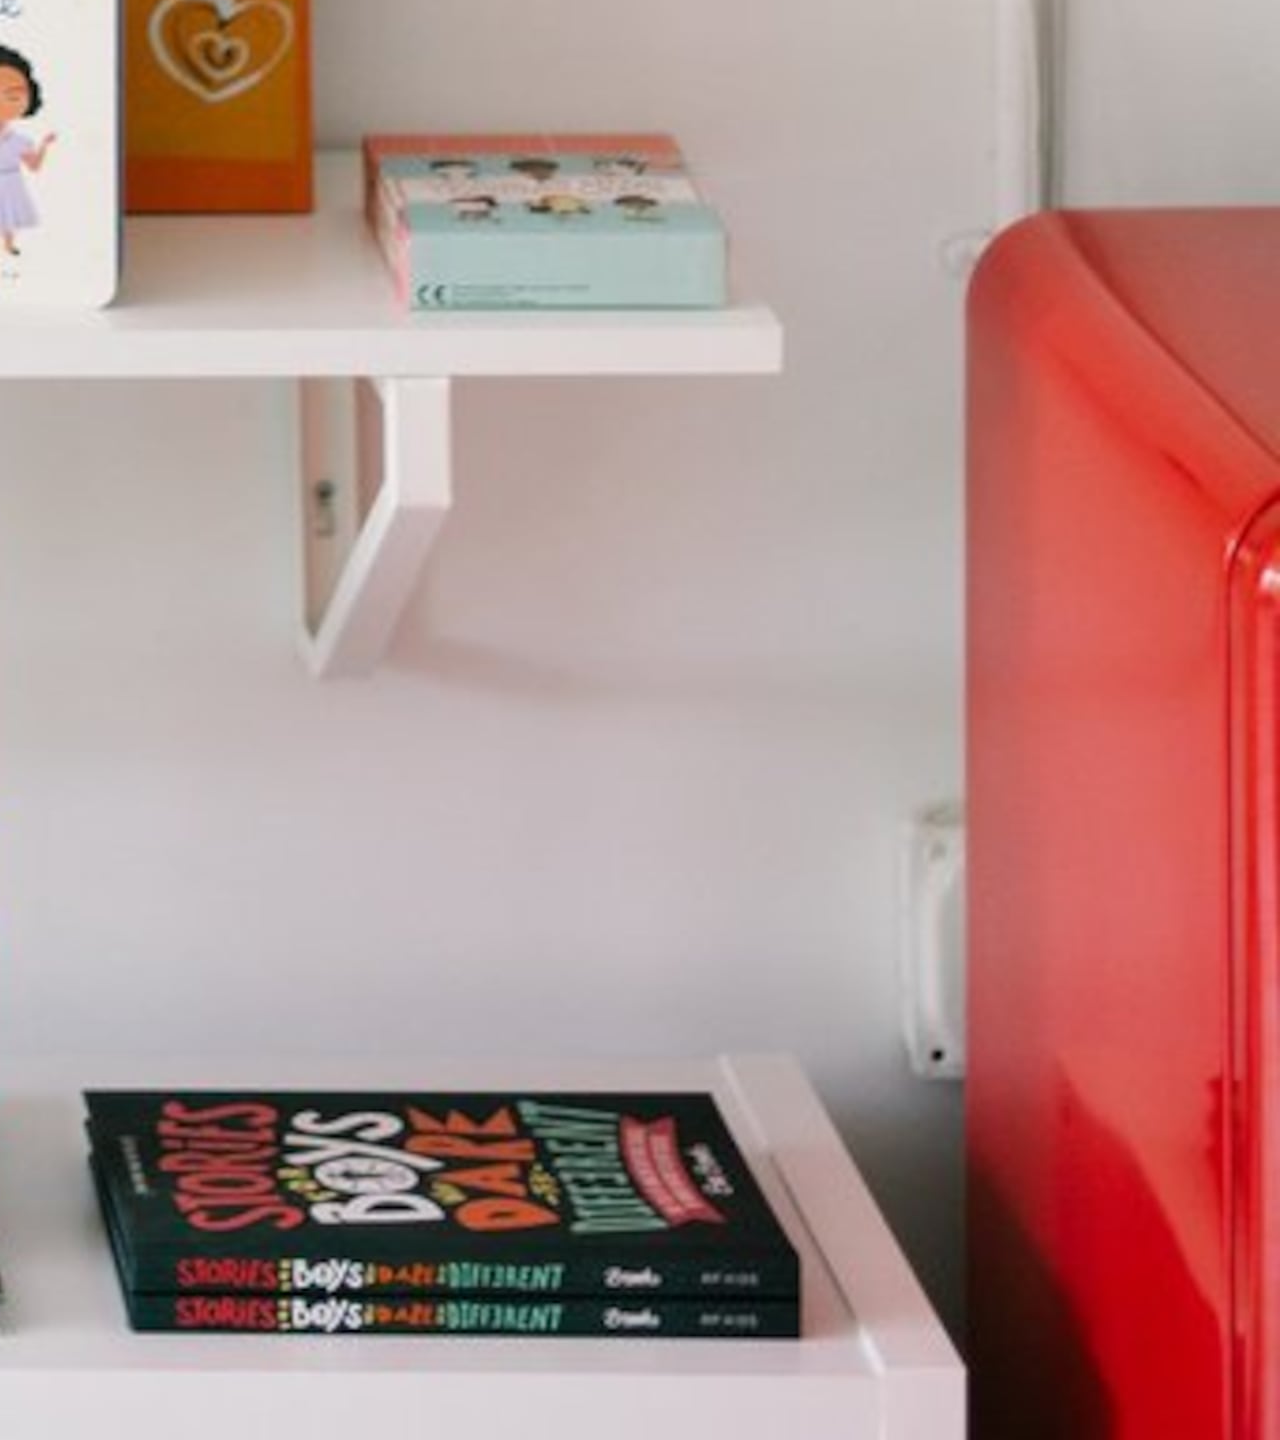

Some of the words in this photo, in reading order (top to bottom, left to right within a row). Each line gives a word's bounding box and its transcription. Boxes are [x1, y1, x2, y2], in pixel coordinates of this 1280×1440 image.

[157, 1100, 304, 1231] STORIES
[284, 1109, 445, 1225] BOYS
[404, 1106, 560, 1231] DARE
[175, 1259, 278, 1290] STORIES
[291, 1257, 363, 1294] BOYS
[446, 1261, 564, 1292] DIFFERENT
[175, 1296, 278, 1329] STORIES
[291, 1295, 363, 1332] BOYS
[445, 1300, 564, 1331] DIFFERENT
